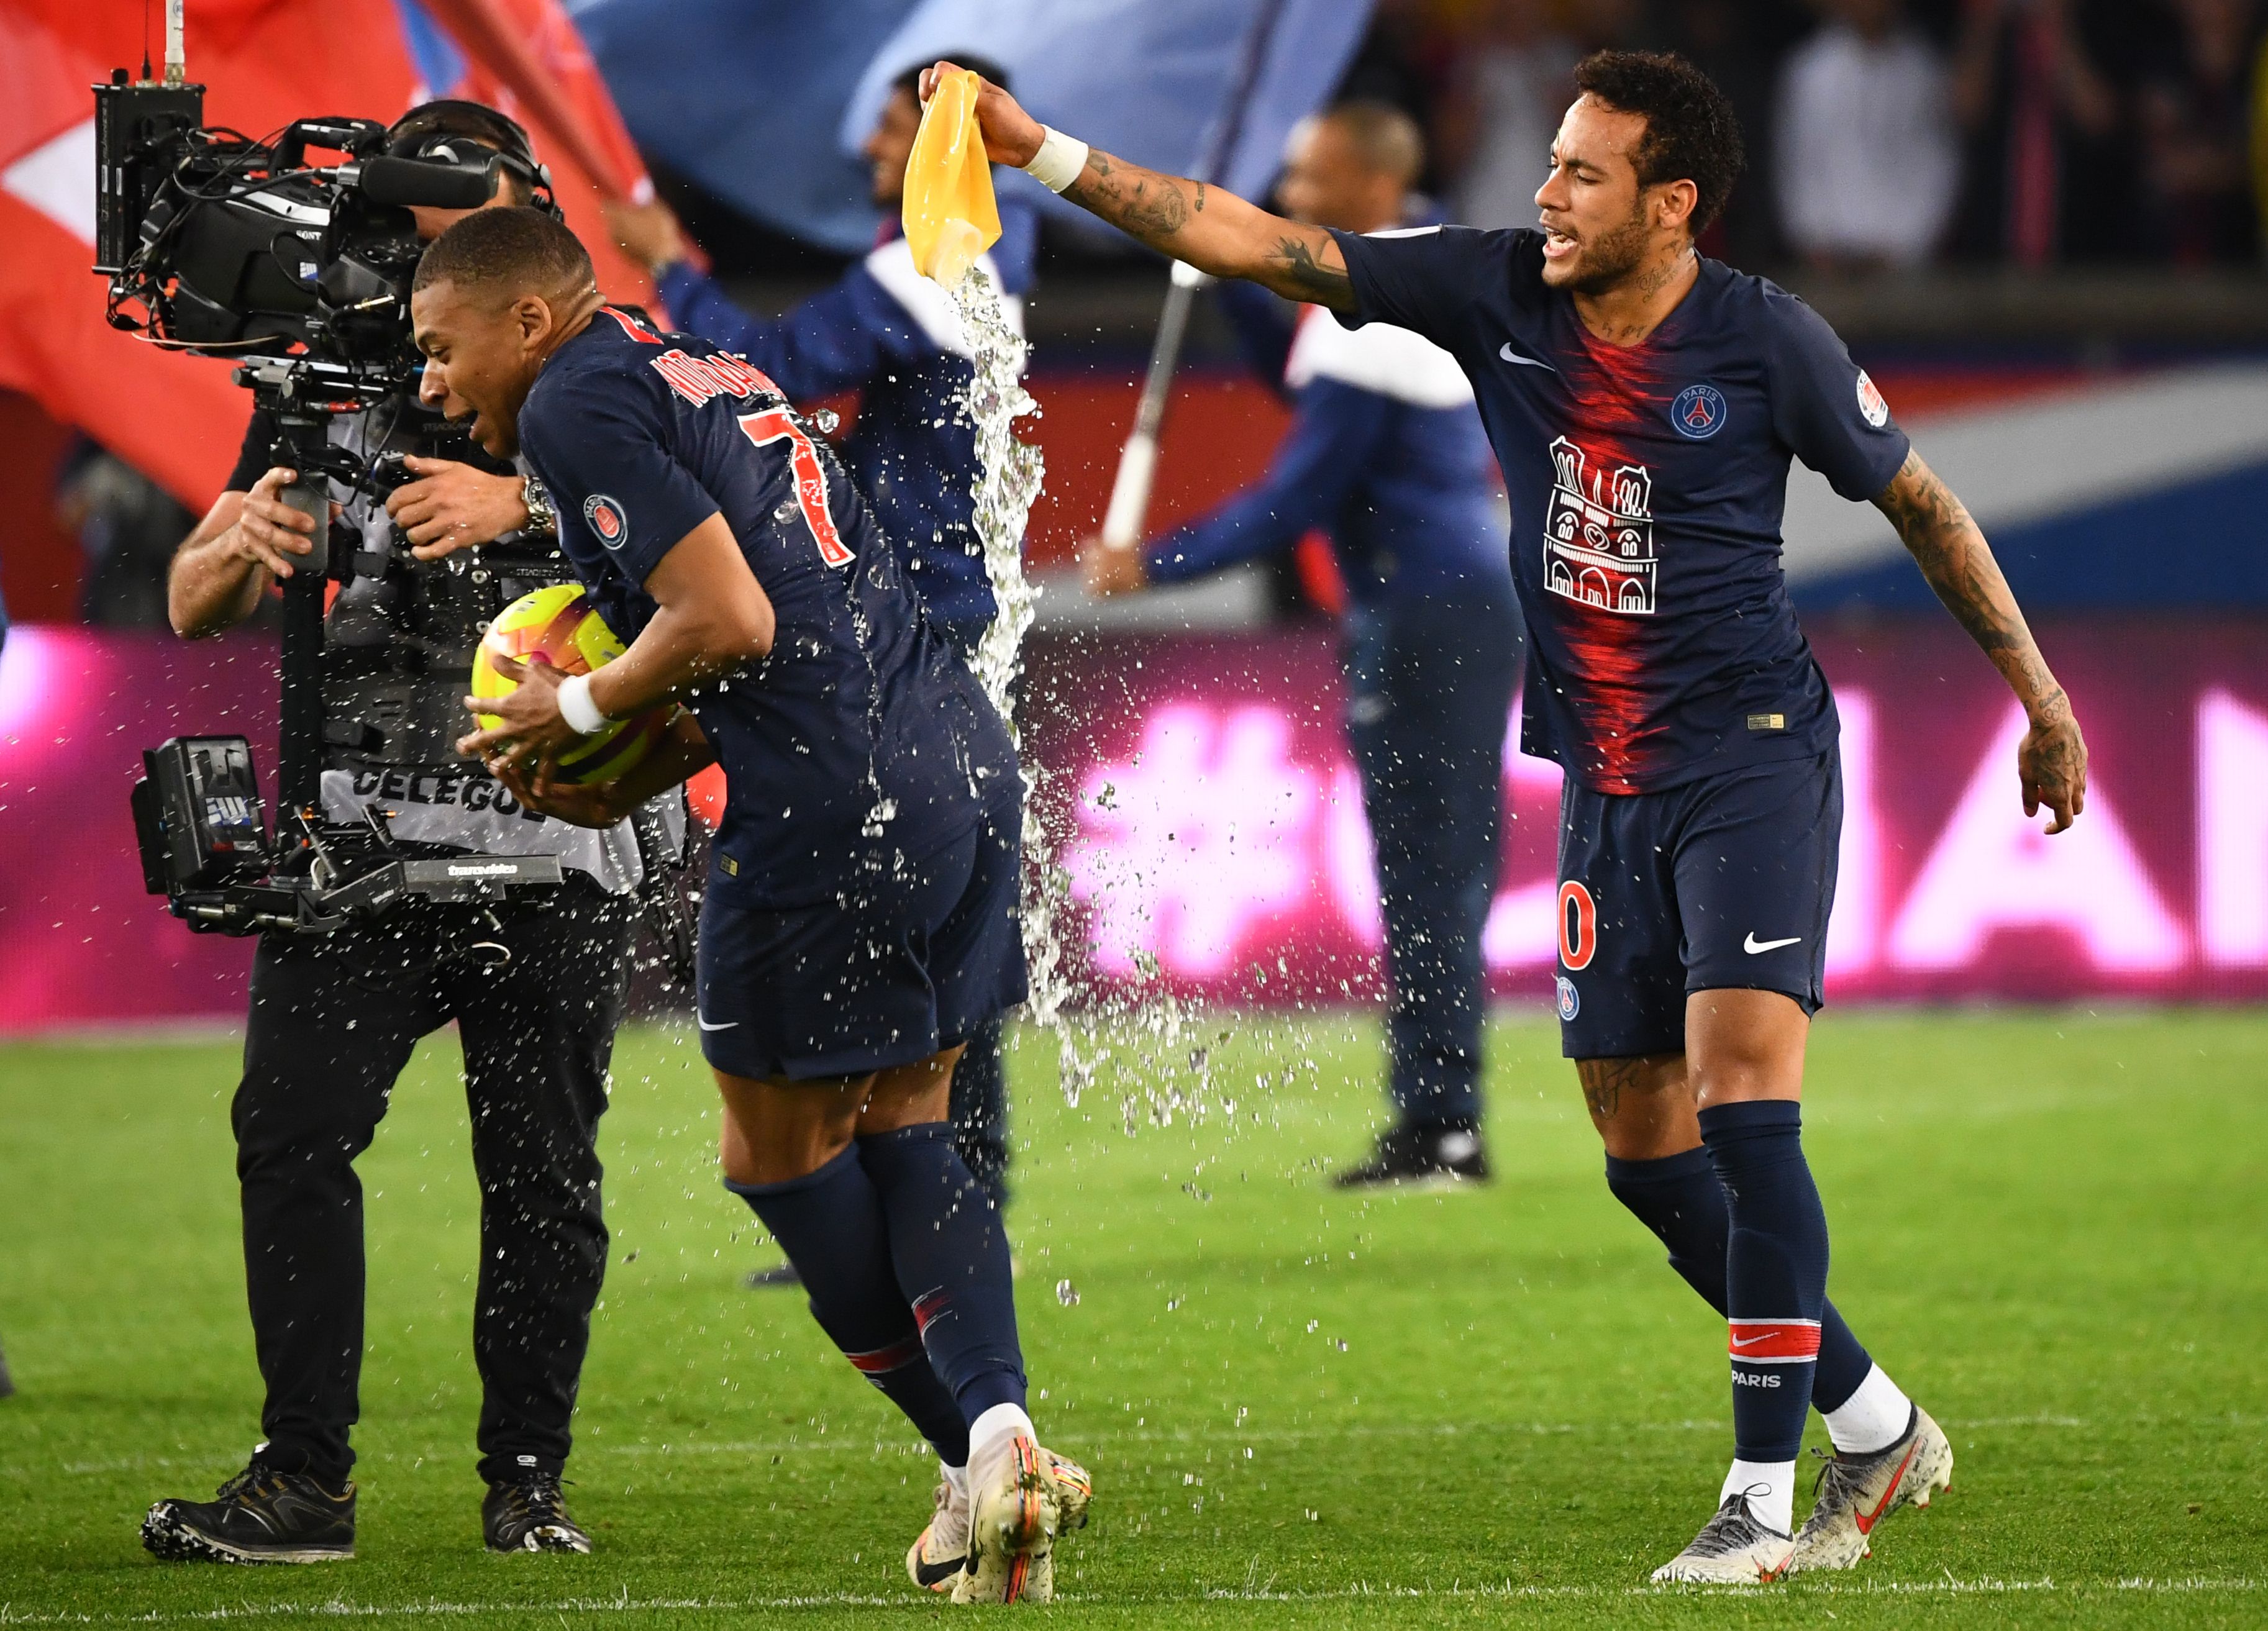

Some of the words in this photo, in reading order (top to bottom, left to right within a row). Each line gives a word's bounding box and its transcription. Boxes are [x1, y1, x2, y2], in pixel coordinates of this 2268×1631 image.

[1683, 388, 1718, 401] PARIS
[737, 405, 855, 568] 7
[448, 863, 517, 876] transvideo
[1731, 1370, 1782, 1388] PARIS
